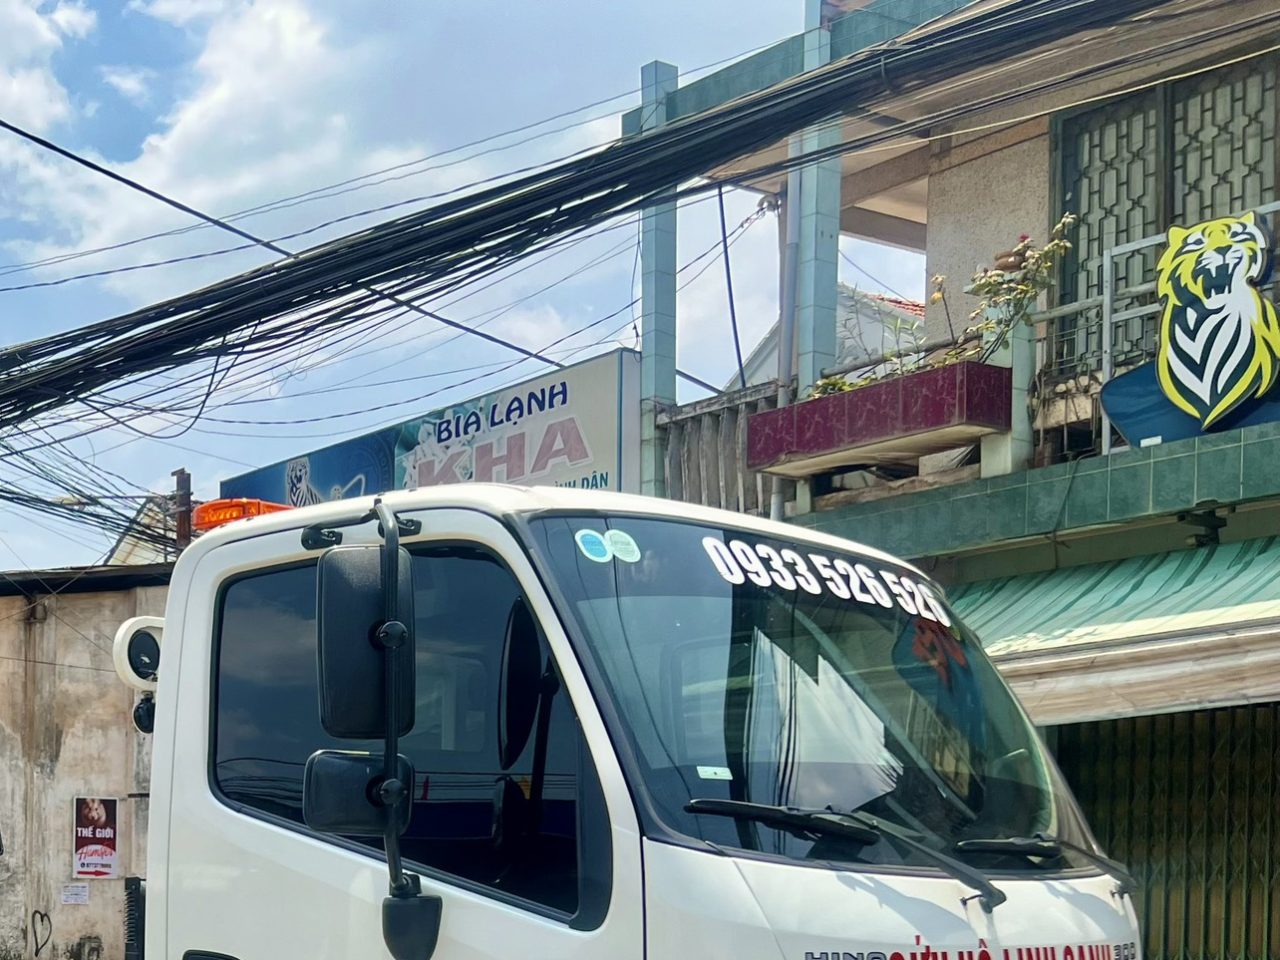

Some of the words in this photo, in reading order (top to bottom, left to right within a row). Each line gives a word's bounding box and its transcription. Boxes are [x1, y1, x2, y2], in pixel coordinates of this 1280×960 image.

[437, 410, 482, 445] BIA
[489, 381, 569, 429] LẠNH
[581, 470, 609, 490] DÂN
[702, 536, 822, 595] 0933
[807, 553, 894, 609] 526
[879, 570, 952, 628] 526
[76, 825, 94, 838] THẾ
[95, 826, 114, 838] GIỚI
